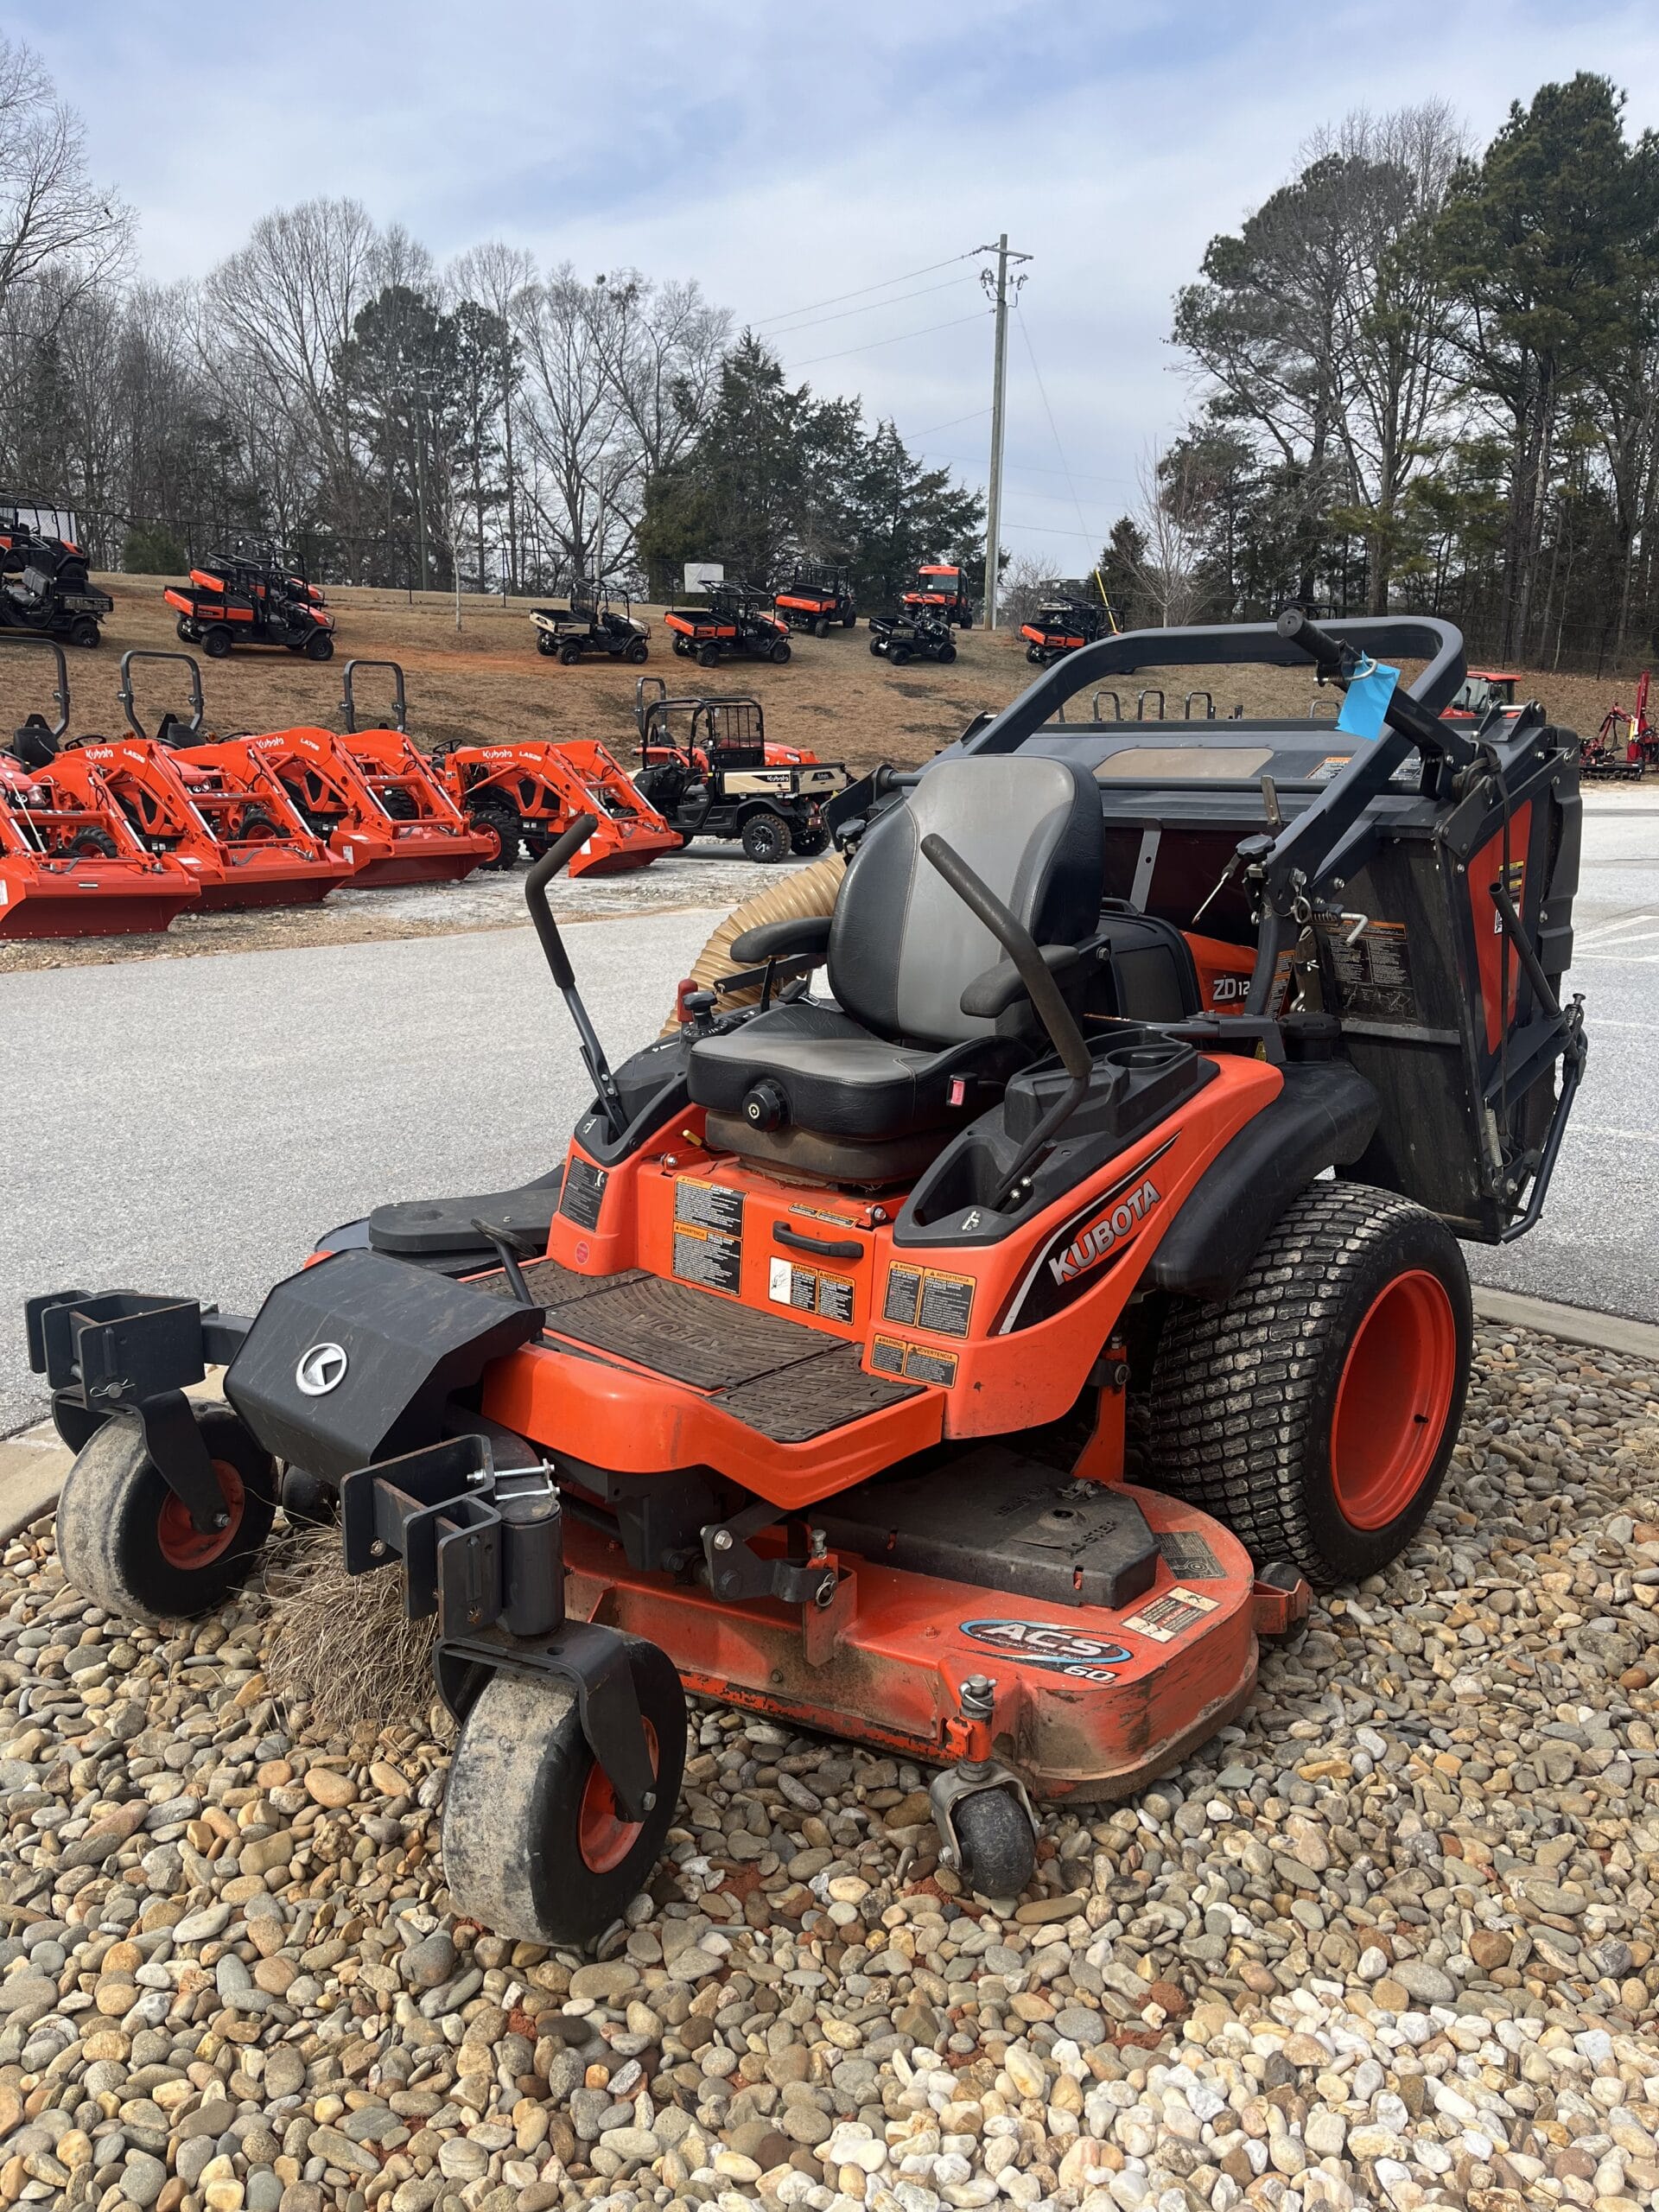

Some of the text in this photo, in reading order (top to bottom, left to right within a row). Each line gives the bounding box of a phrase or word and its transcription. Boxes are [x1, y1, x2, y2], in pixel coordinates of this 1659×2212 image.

[257, 736, 284, 749] Kubota
[86, 747, 114, 760] Kubota
[482, 749, 513, 760] Kubota
[1212, 978, 1236, 1001] ZD
[1048, 1179, 1161, 1286] KUBOTA
[937, 1272, 969, 1283] ADVERTENCIA
[628, 1313, 725, 1351] KUBOTA
[881, 1338, 903, 1347] WARNING
[981, 1623, 1111, 1657] ACS
[1064, 1664, 1117, 1681] 60
